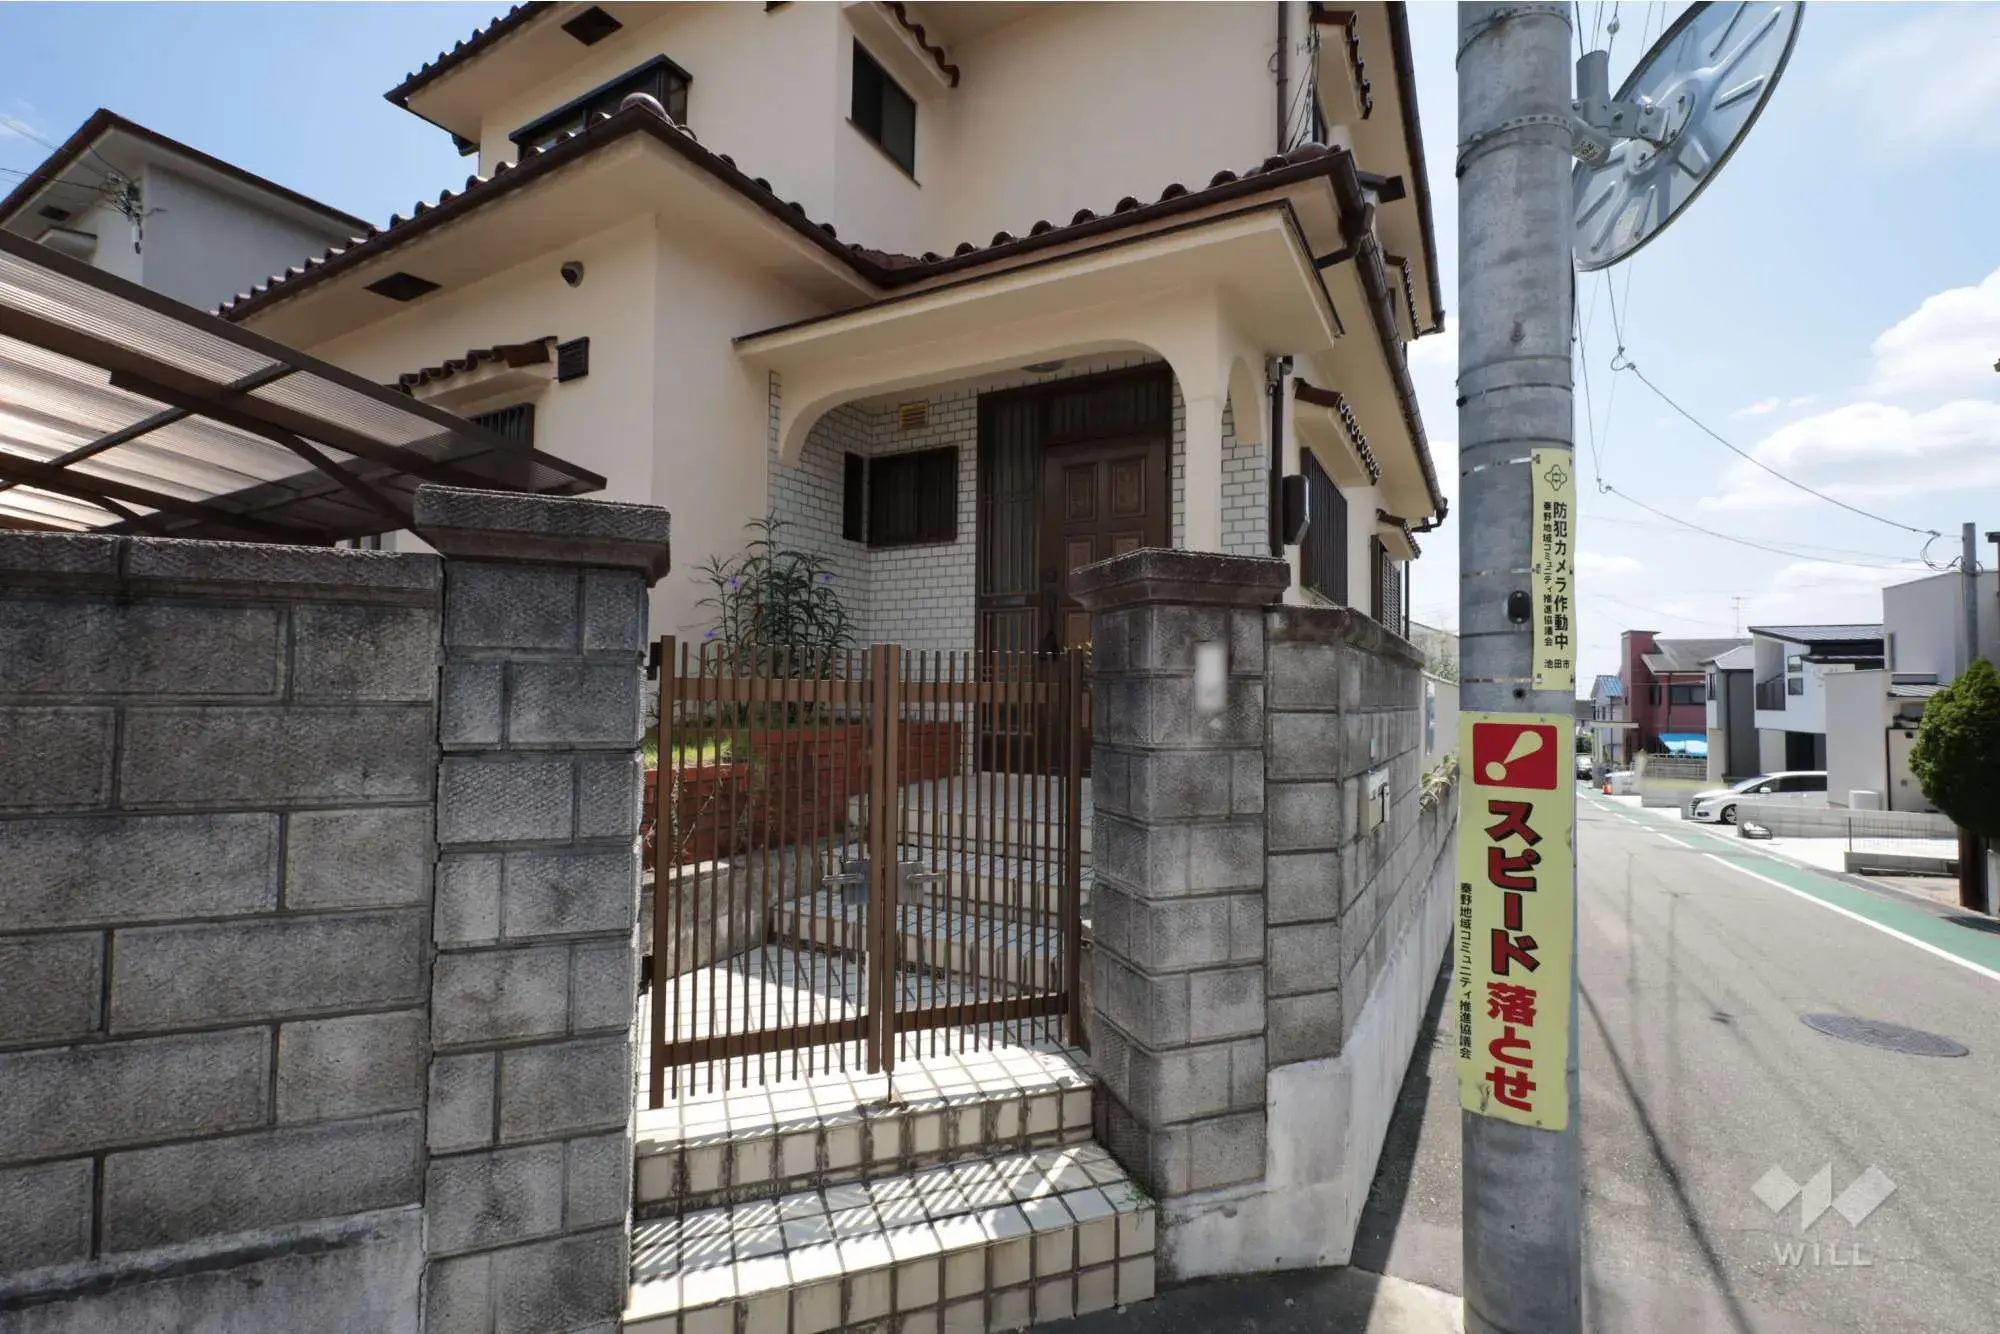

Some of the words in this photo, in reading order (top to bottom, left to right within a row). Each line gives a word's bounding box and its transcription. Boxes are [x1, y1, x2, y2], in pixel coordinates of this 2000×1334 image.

[1553, 501, 1568, 650] 防犯カメラ作動中
[1544, 659, 1570, 669] 池田市
